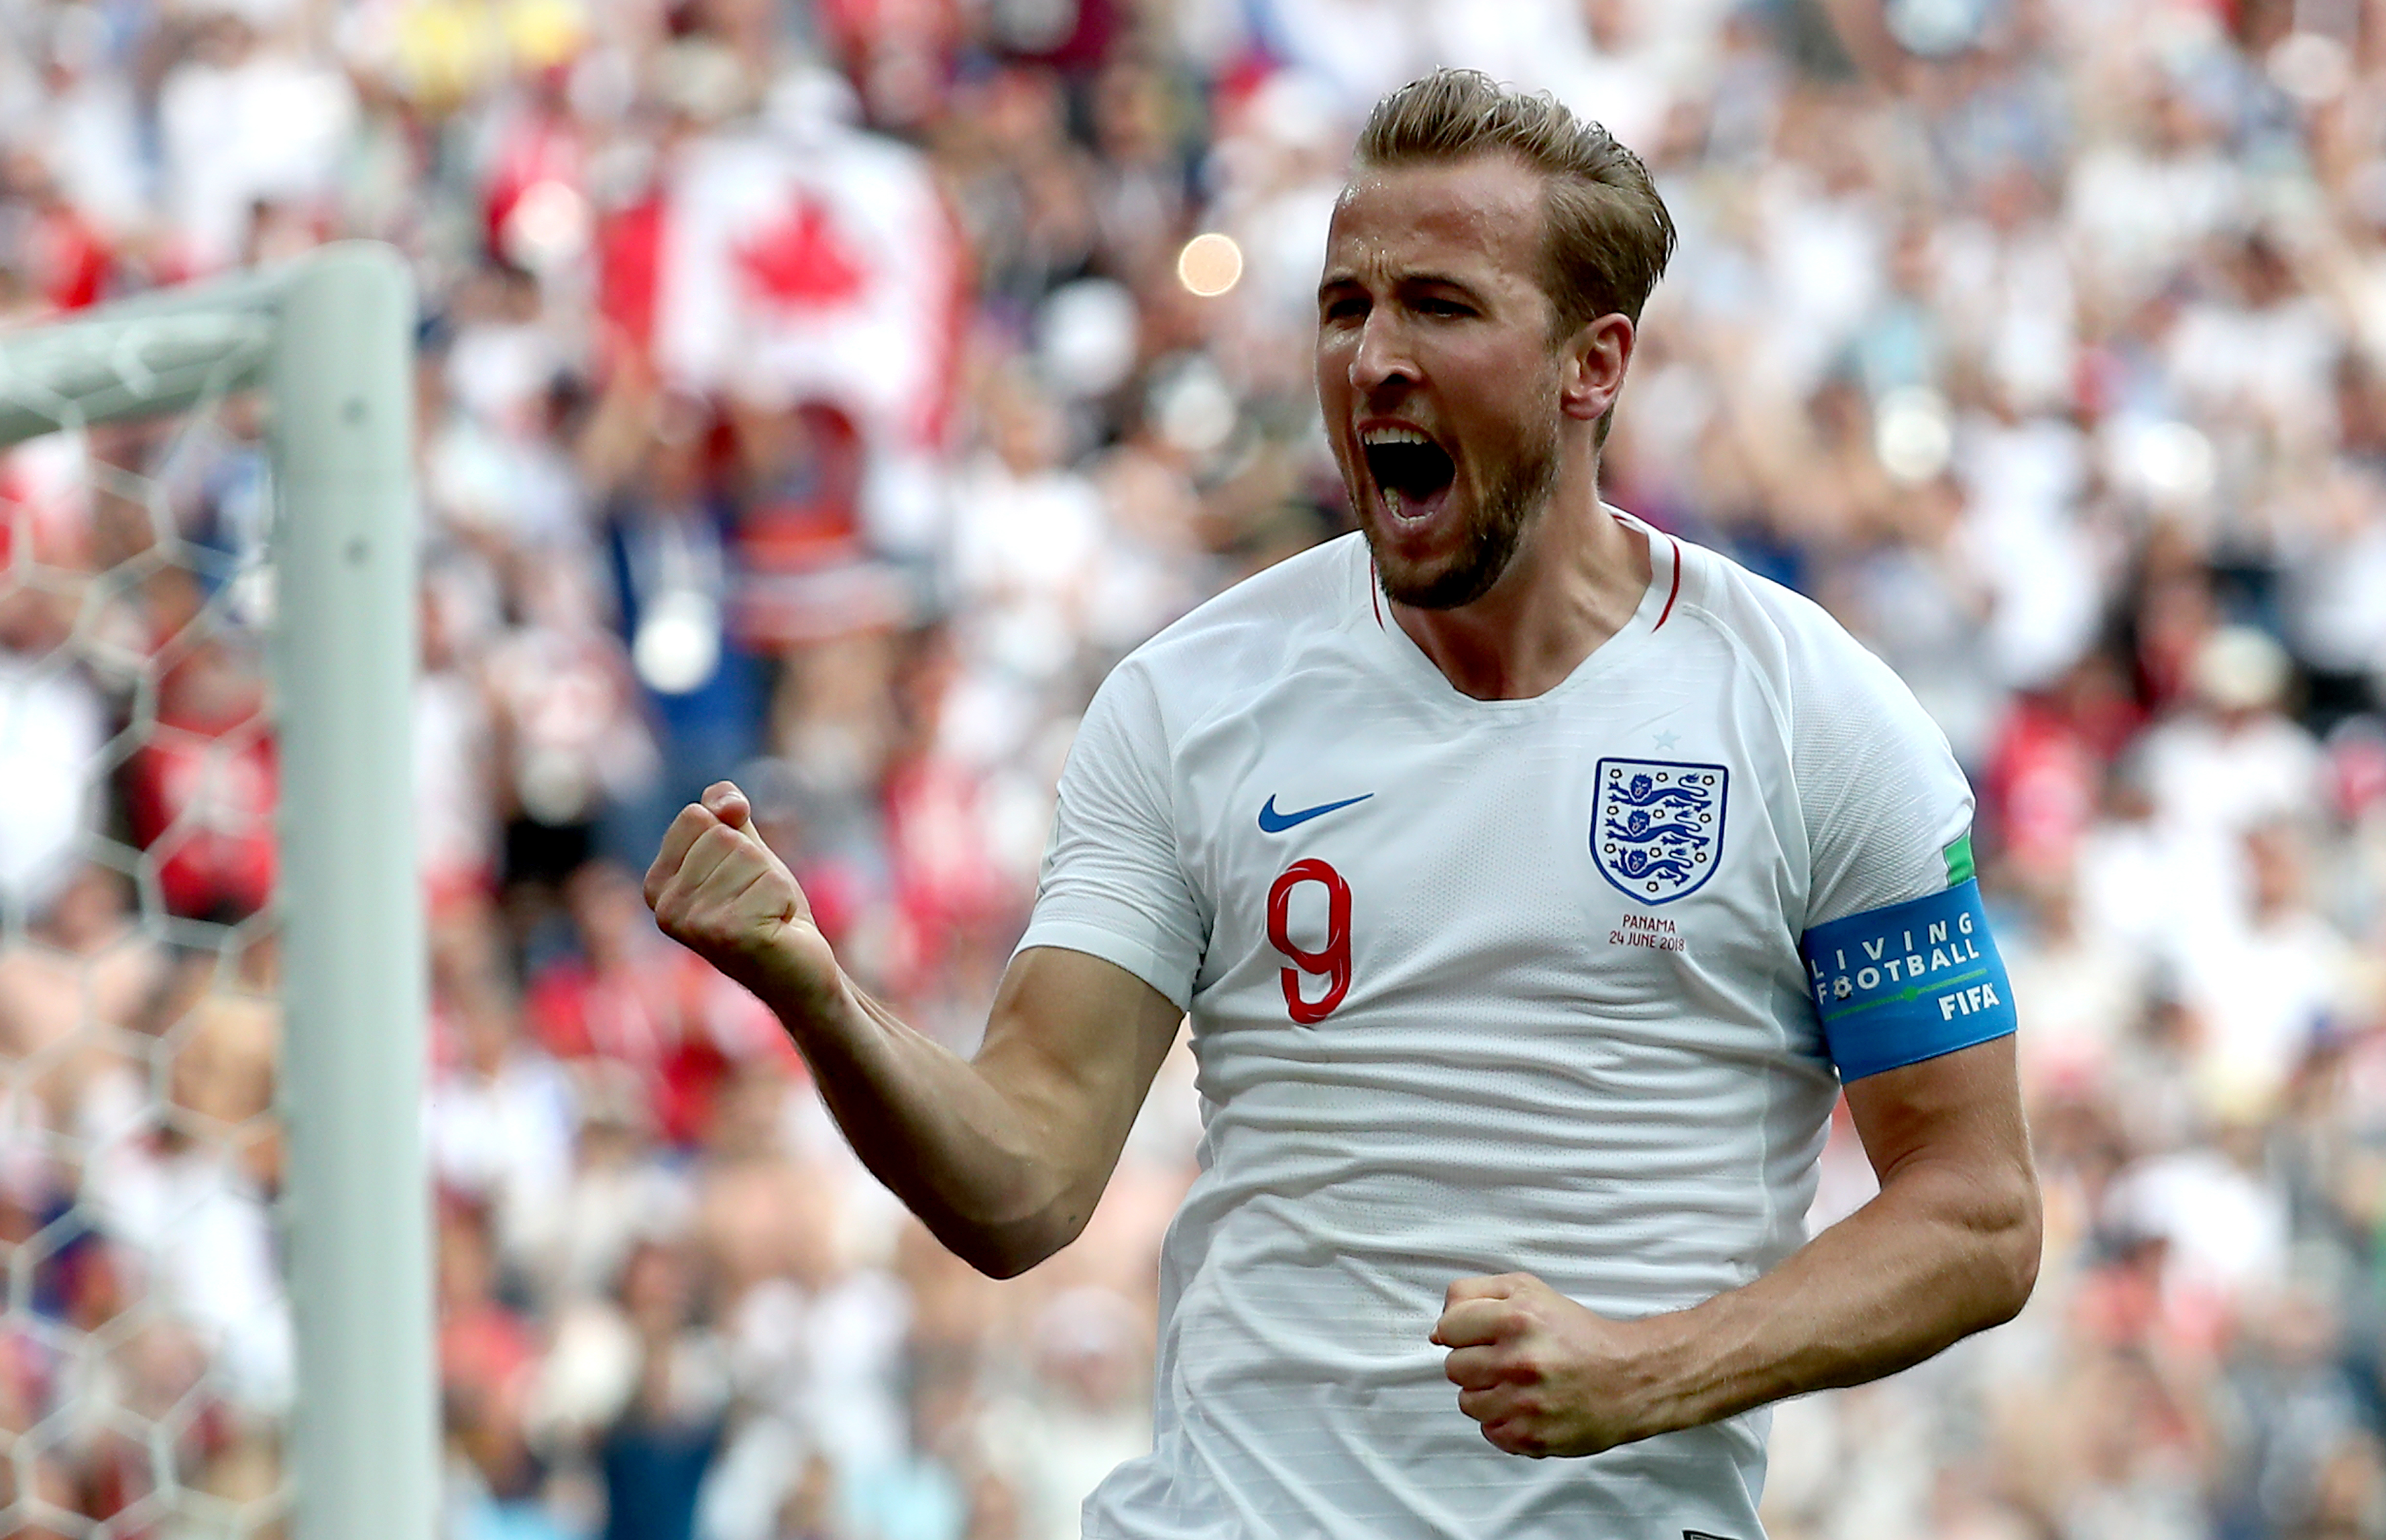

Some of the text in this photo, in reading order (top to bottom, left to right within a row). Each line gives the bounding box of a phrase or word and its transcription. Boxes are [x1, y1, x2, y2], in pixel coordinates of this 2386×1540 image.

[1267, 858, 1351, 1024] 9
[1609, 930, 1684, 952] 24 JUNE 2018
[1622, 914, 1676, 934] PANAMA
[1811, 912, 1973, 979] LIVING
[1938, 982, 2000, 1021] FIFA
